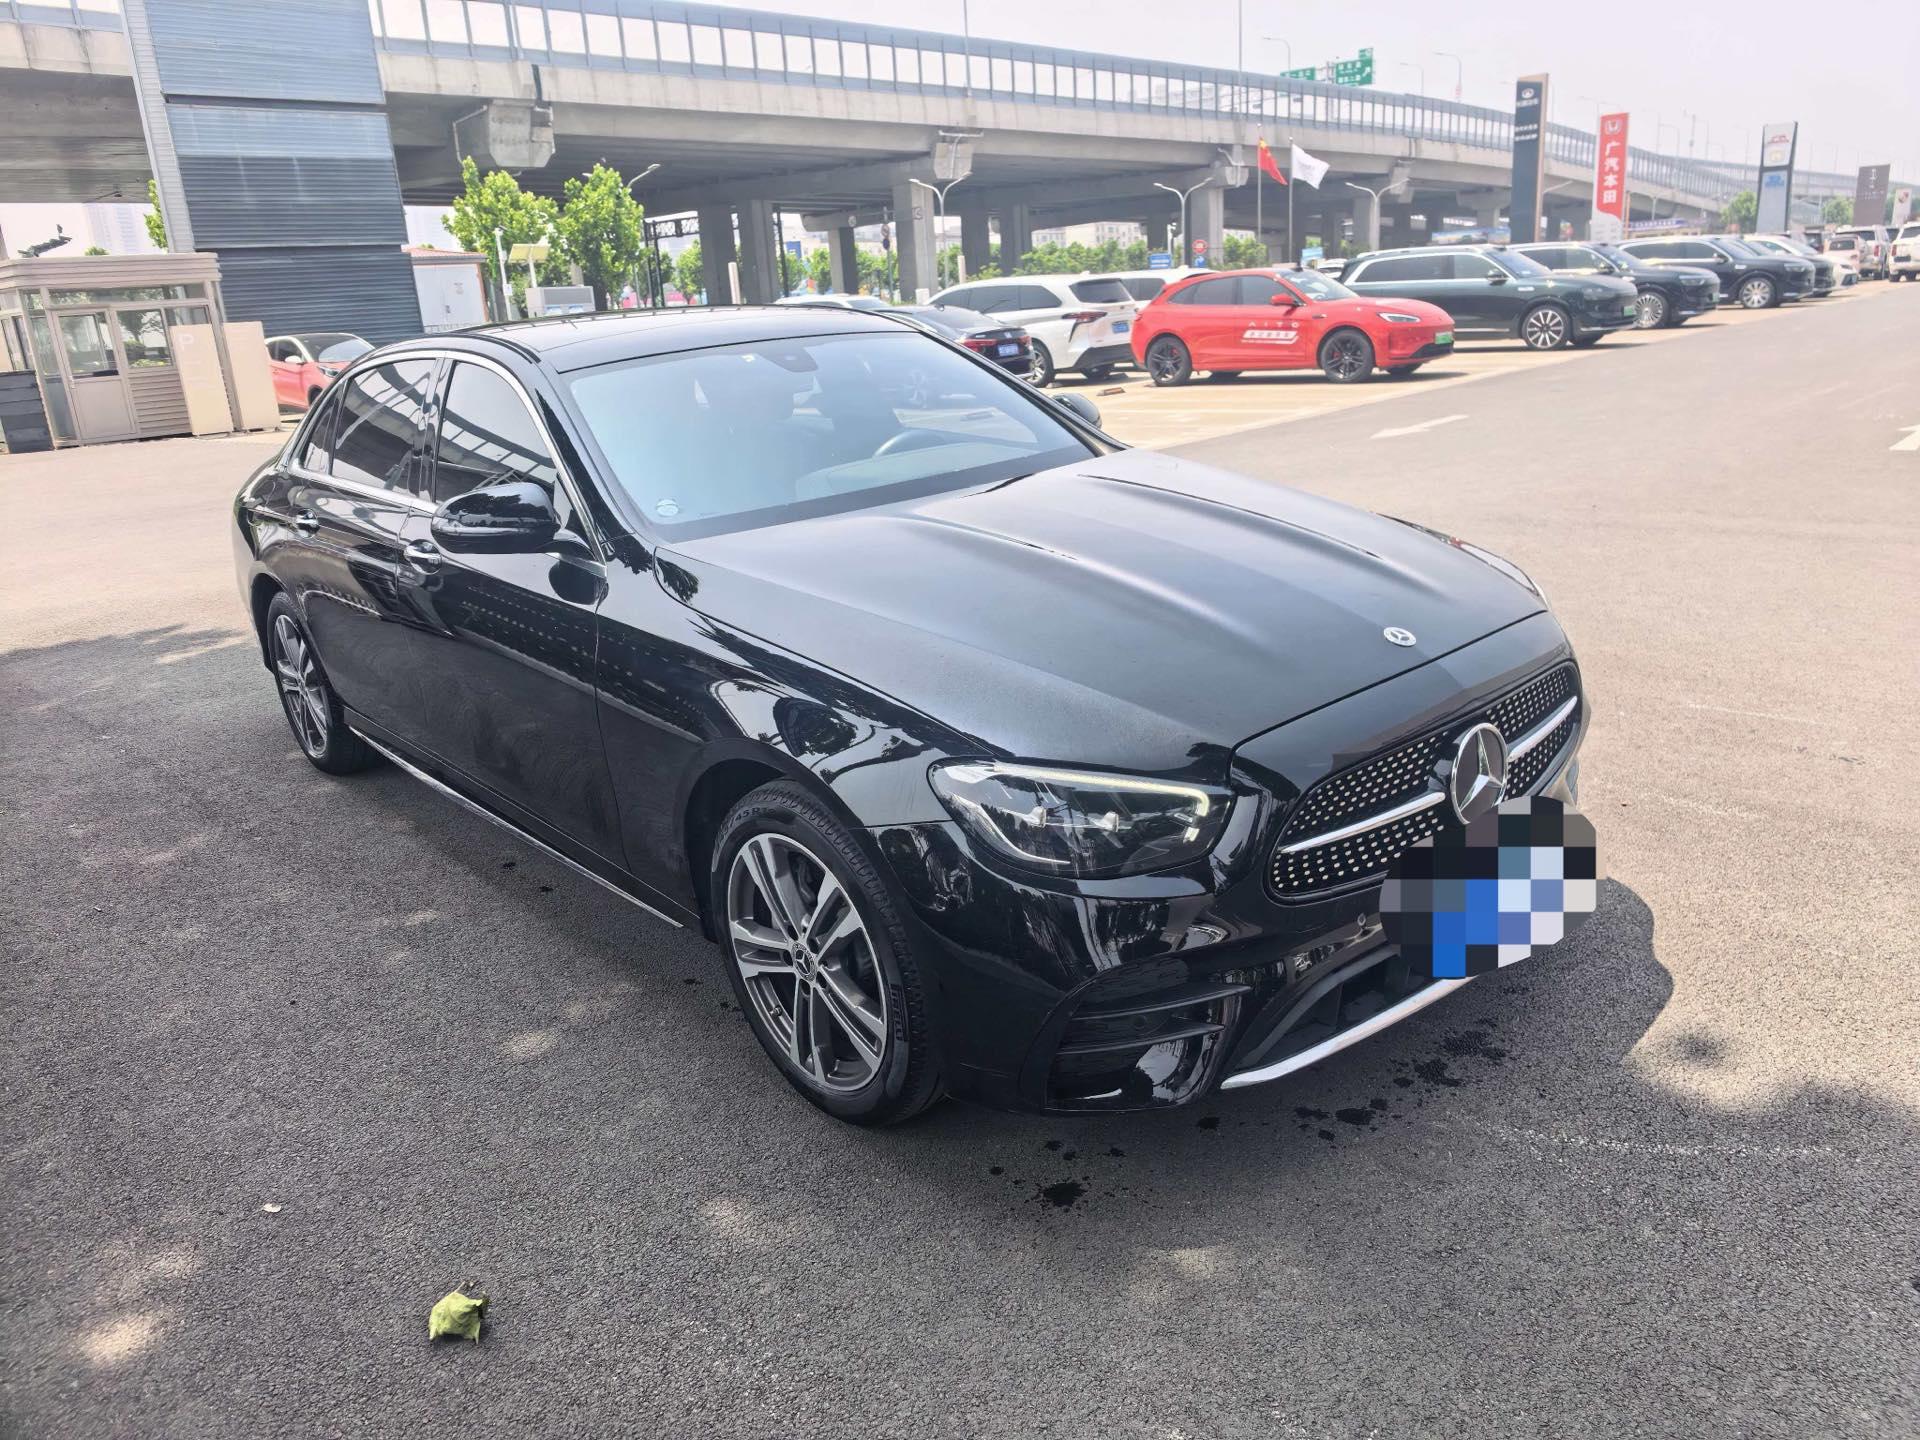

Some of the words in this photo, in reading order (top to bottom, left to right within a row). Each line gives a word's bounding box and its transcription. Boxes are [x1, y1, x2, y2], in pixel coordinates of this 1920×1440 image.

[1603, 141, 1621, 204] 广汽本田
[178, 333, 194, 351] P
